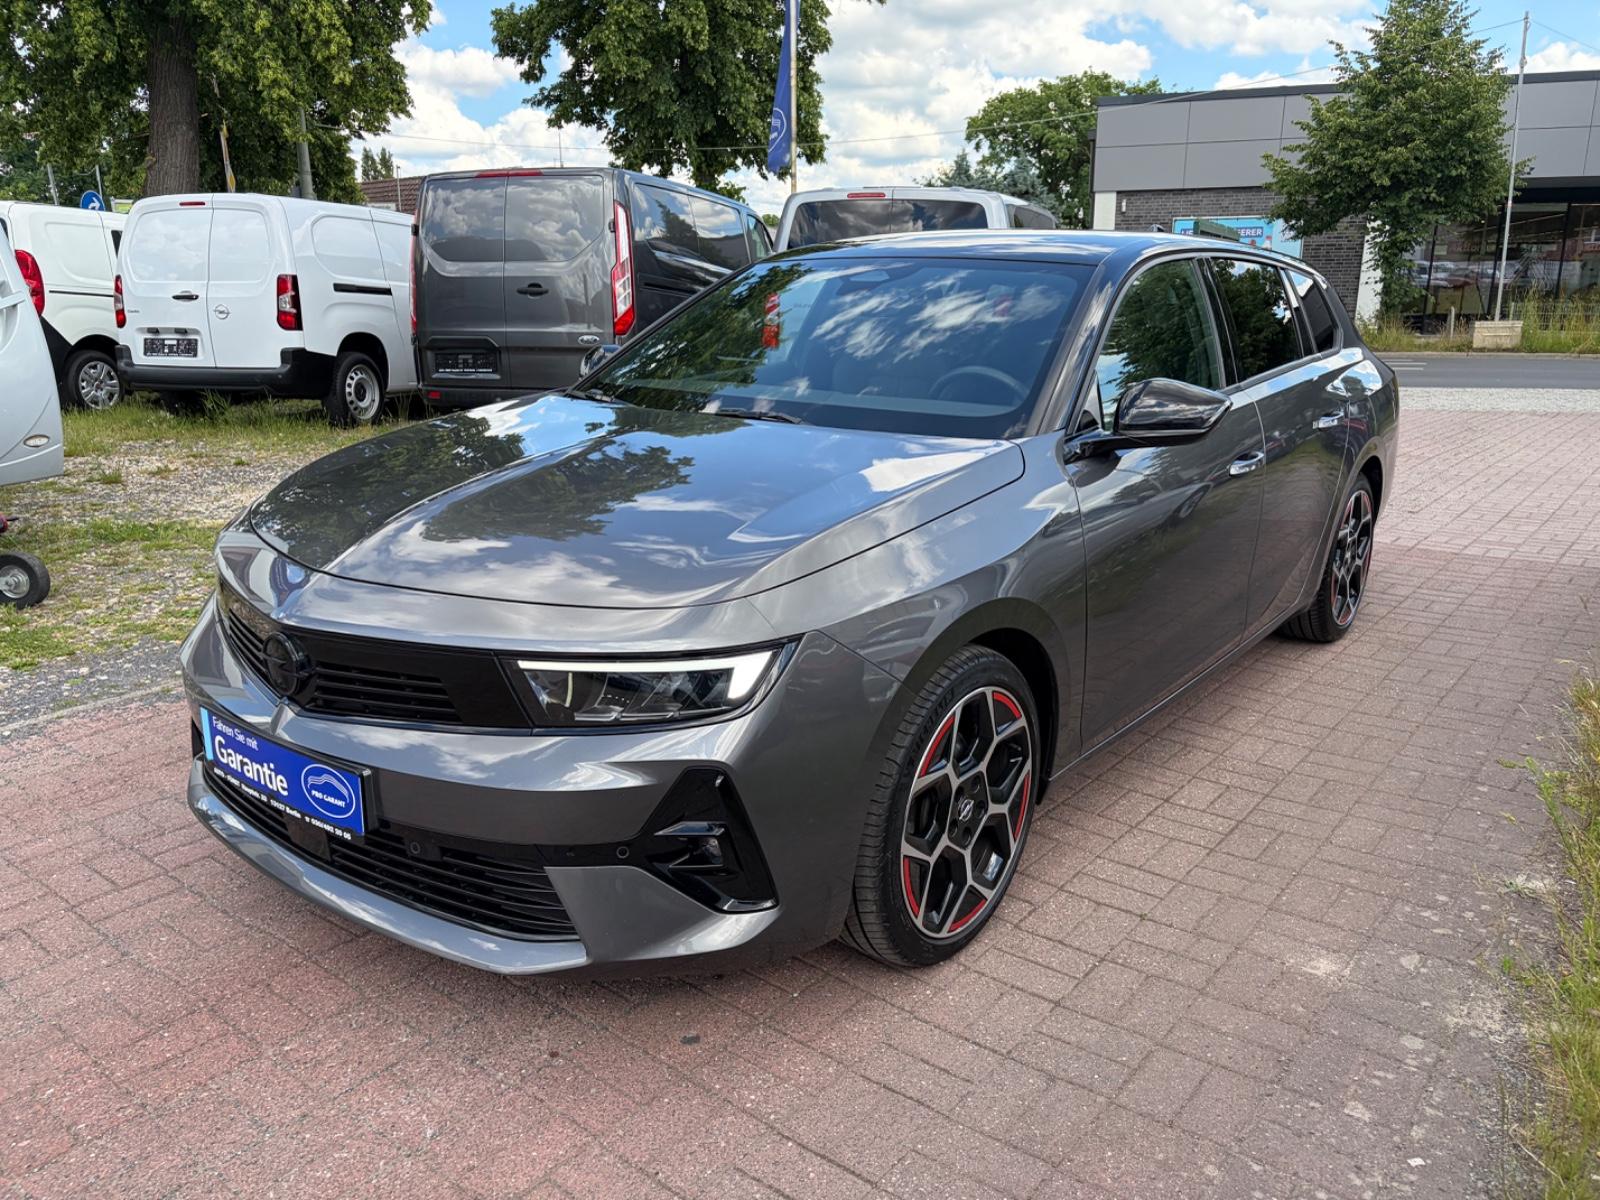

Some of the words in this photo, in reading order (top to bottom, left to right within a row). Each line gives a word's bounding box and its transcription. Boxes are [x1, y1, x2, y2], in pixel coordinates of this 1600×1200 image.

[212, 715, 234, 738] Fahren
[234, 728, 246, 744] Sie
[214, 735, 289, 796] Garantie
[311, 790, 324, 800] PRO
[323, 794, 346, 808] GARANT
